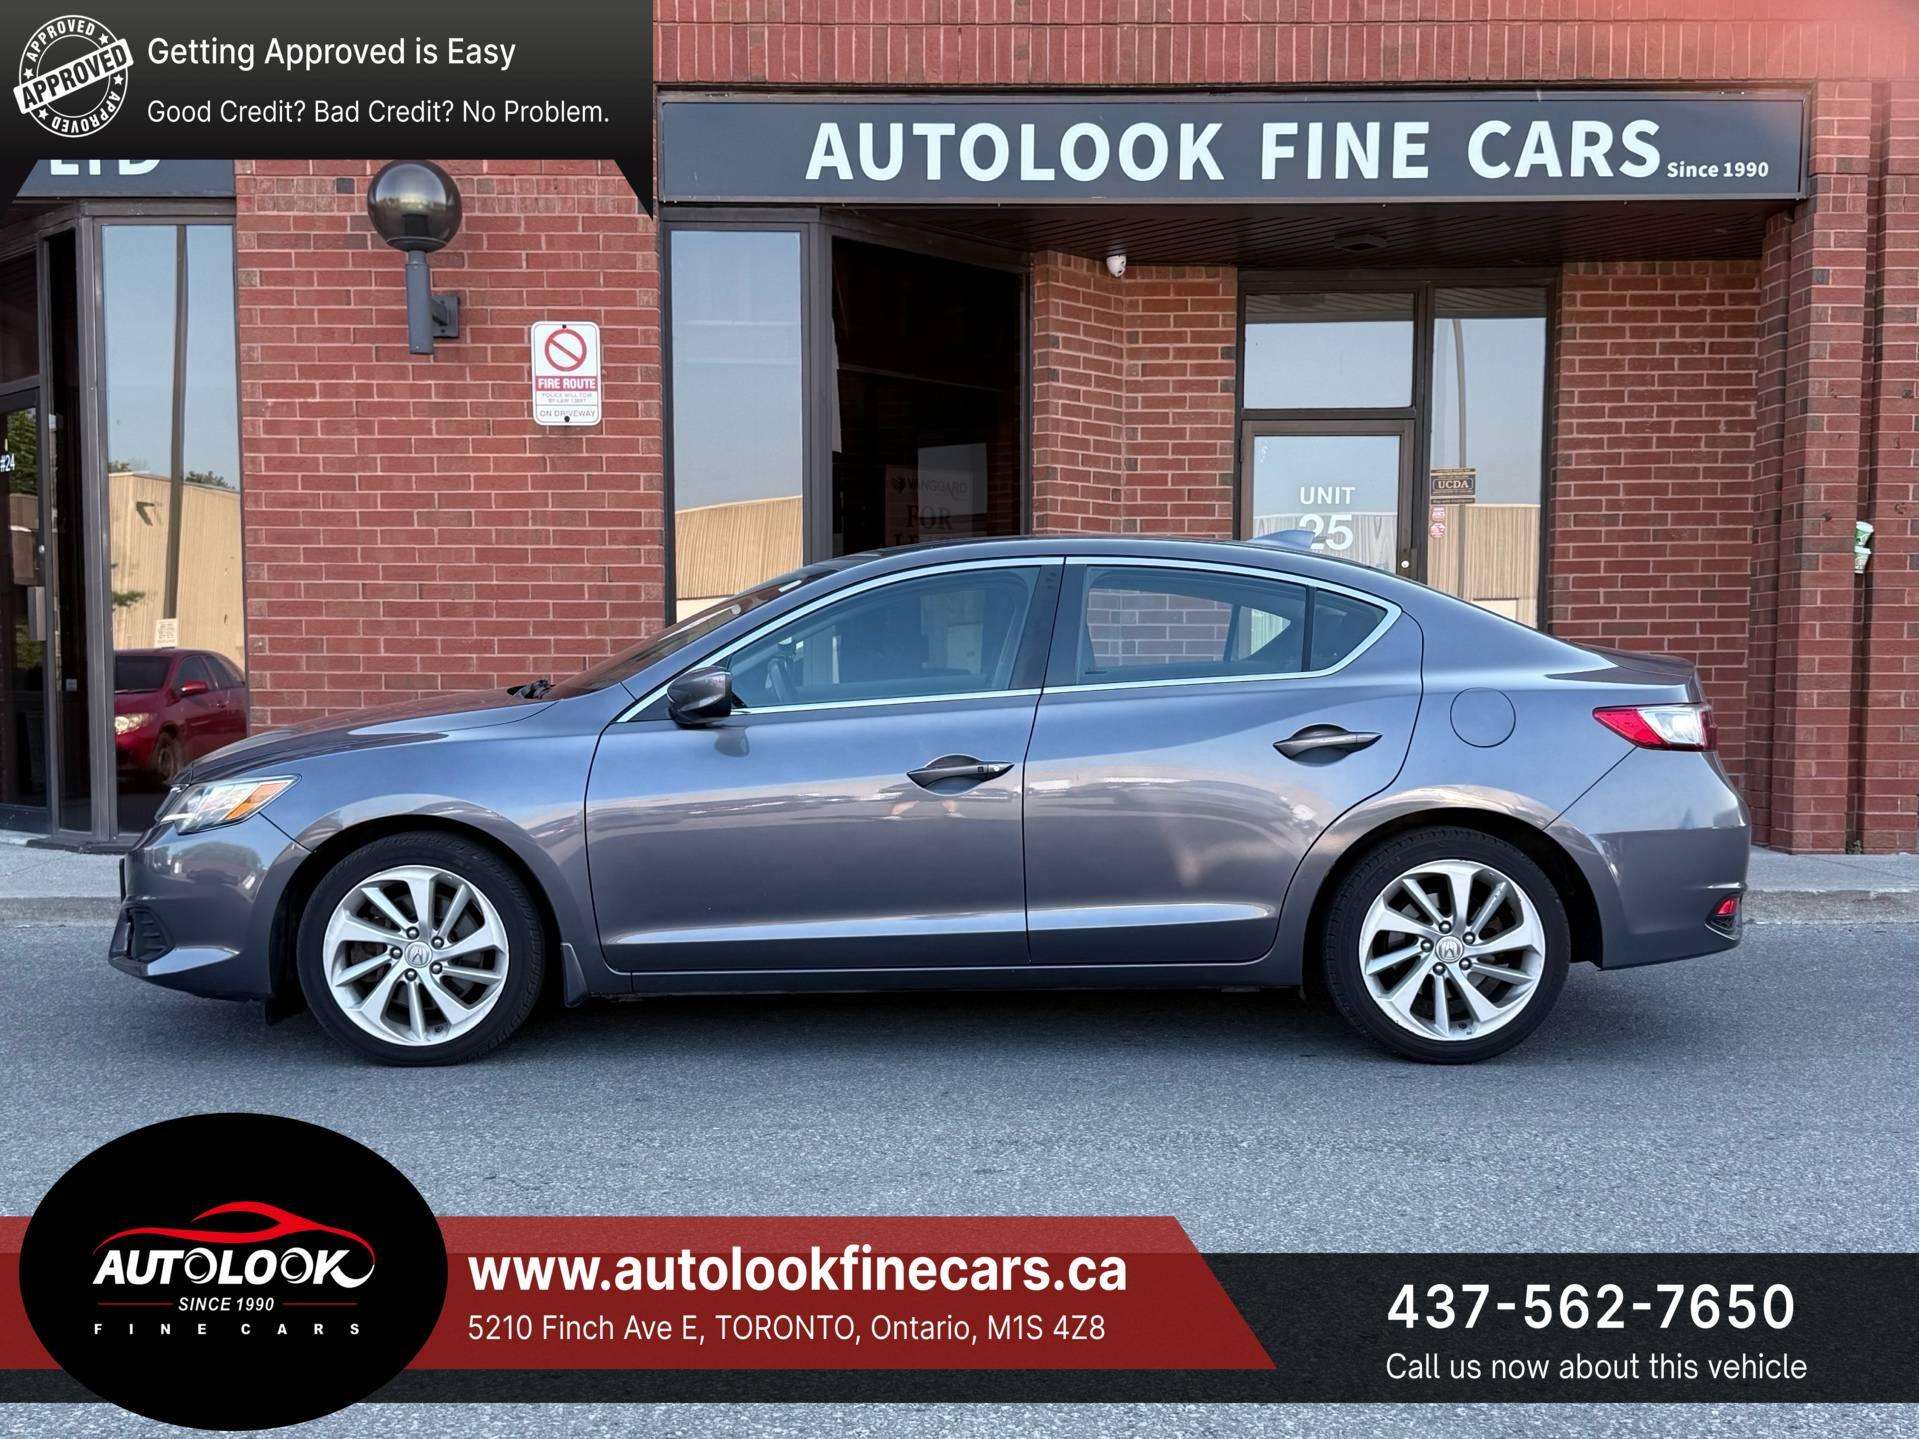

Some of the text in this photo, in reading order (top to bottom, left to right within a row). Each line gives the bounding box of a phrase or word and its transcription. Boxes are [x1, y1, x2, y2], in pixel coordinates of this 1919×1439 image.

[805, 119, 1661, 182] AUTOLOOK FINE CARS
[1667, 160, 1769, 178] Since 1990
[538, 378, 596, 389] FIRE ROUTE
[540, 409, 596, 418] ON DRIVEWAY
[0, 453, 15, 472] #24
[1437, 479, 1469, 489] UCDA
[1299, 486, 1356, 505] UNIT
[1298, 513, 1354, 551] 25
